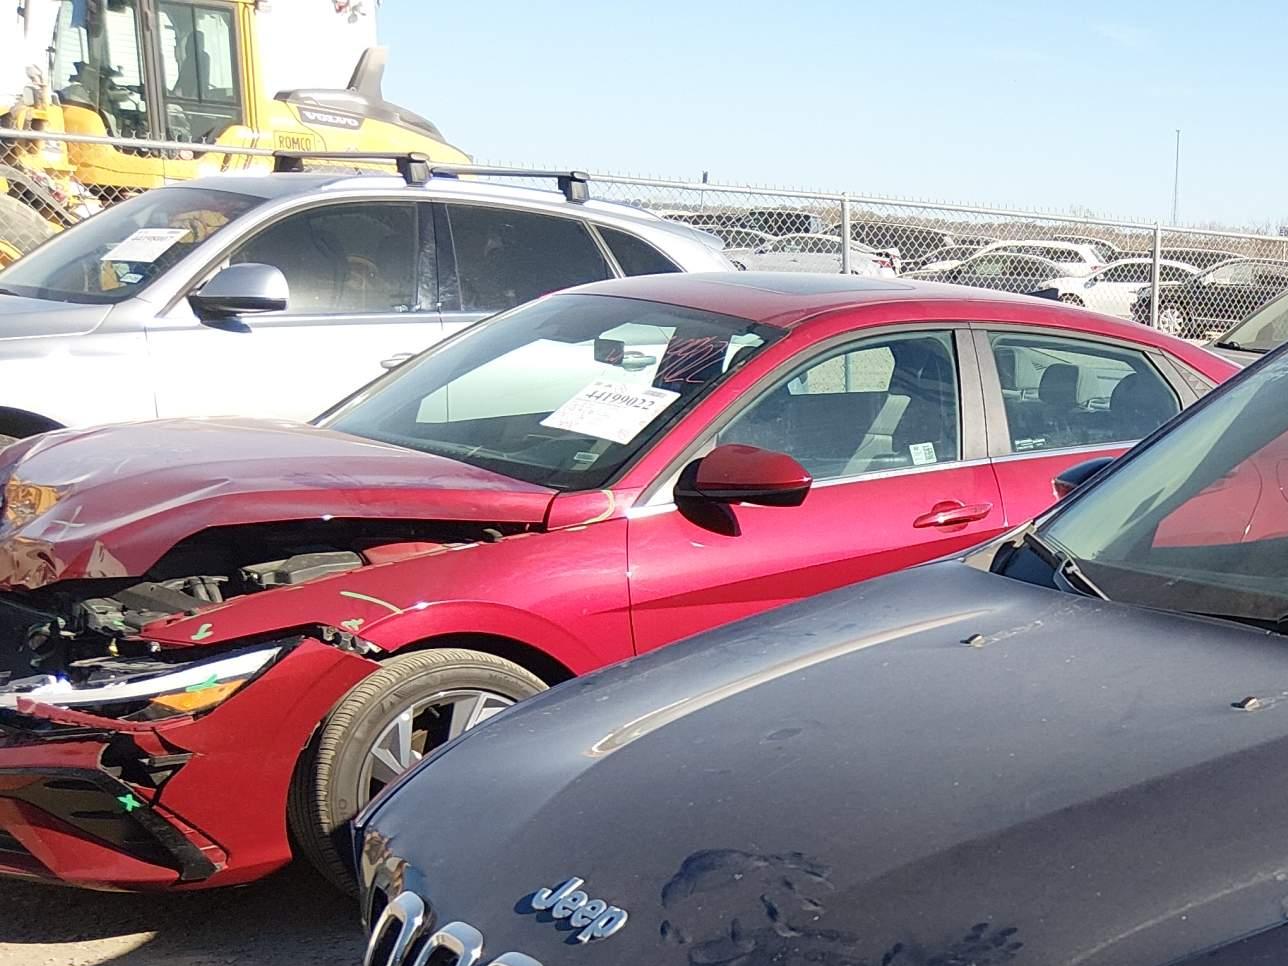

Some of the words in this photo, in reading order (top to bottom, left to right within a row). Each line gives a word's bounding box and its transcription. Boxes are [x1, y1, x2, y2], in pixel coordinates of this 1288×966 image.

[302, 110, 360, 127] VOLVO
[278, 135, 312, 151] ROMCO
[586, 390, 656, 409] 44199022
[531, 876, 629, 944] Jeep
